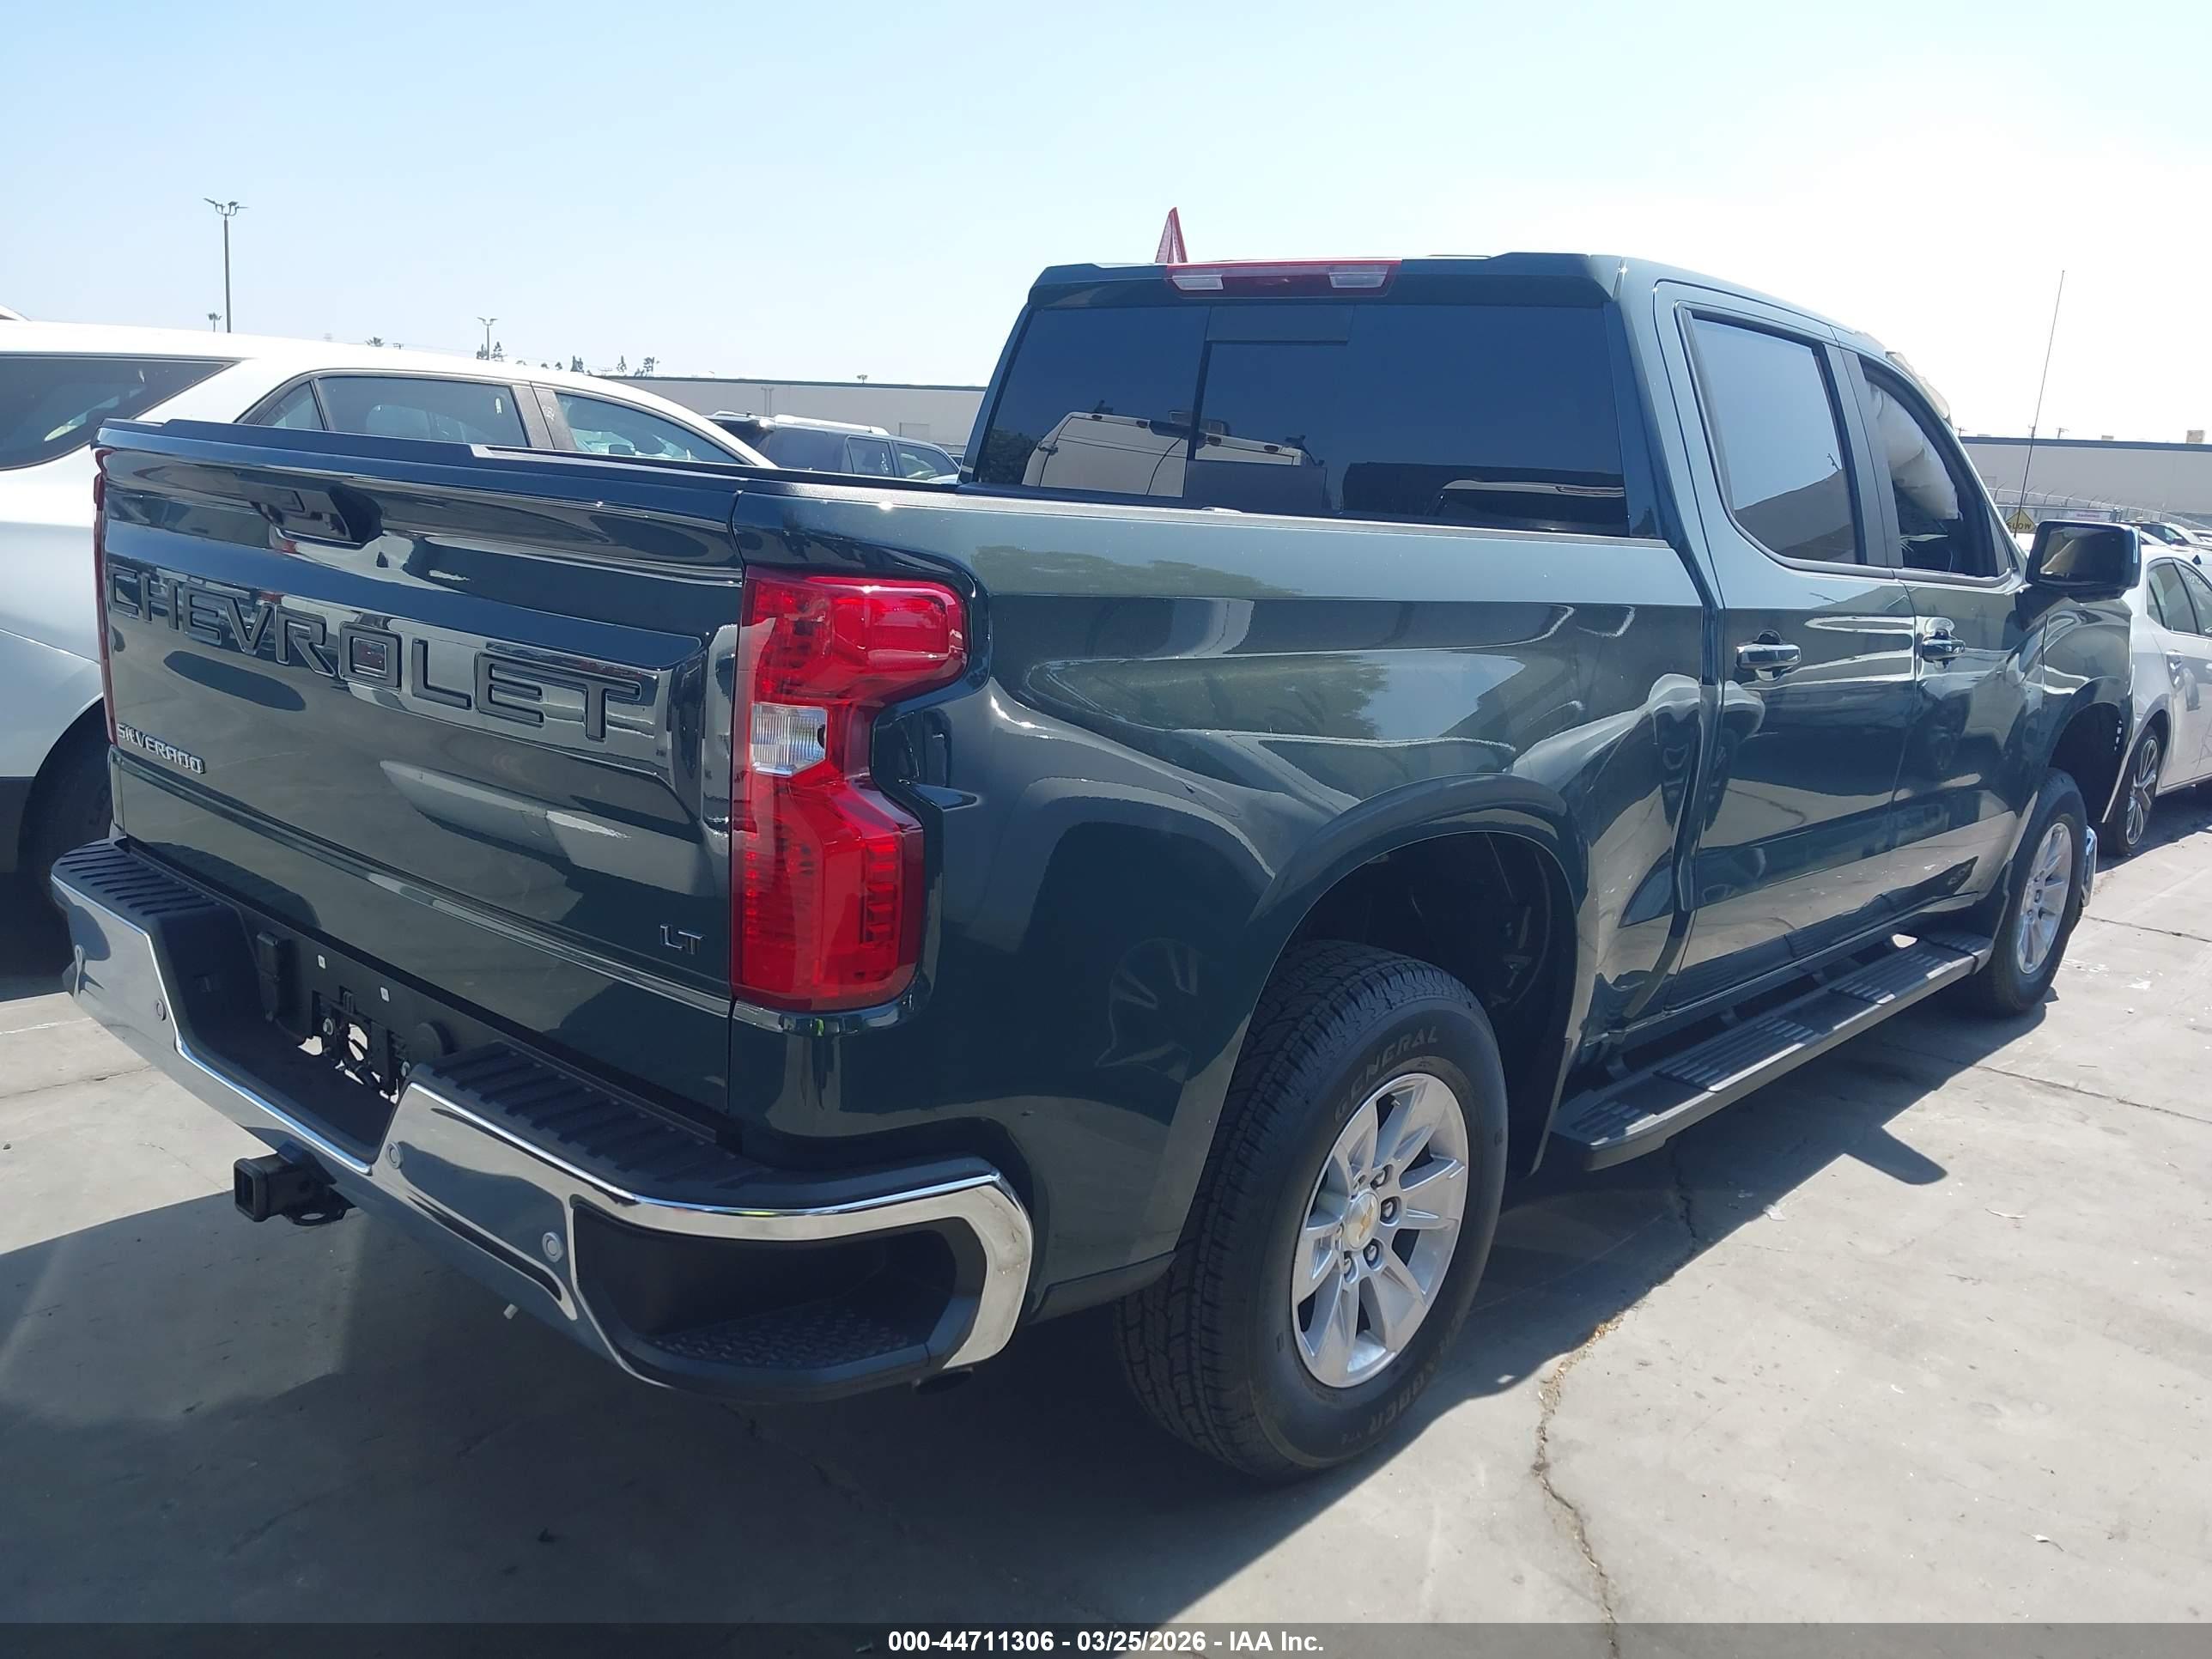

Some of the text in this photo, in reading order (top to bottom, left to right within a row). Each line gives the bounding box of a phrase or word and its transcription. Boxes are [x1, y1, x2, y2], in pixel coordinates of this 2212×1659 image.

[107, 562, 642, 742] CHEVROLET
[117, 722, 206, 774] SILVERADO
[659, 924, 706, 955] LT
[1334, 1025, 1439, 1122] GENERAL
